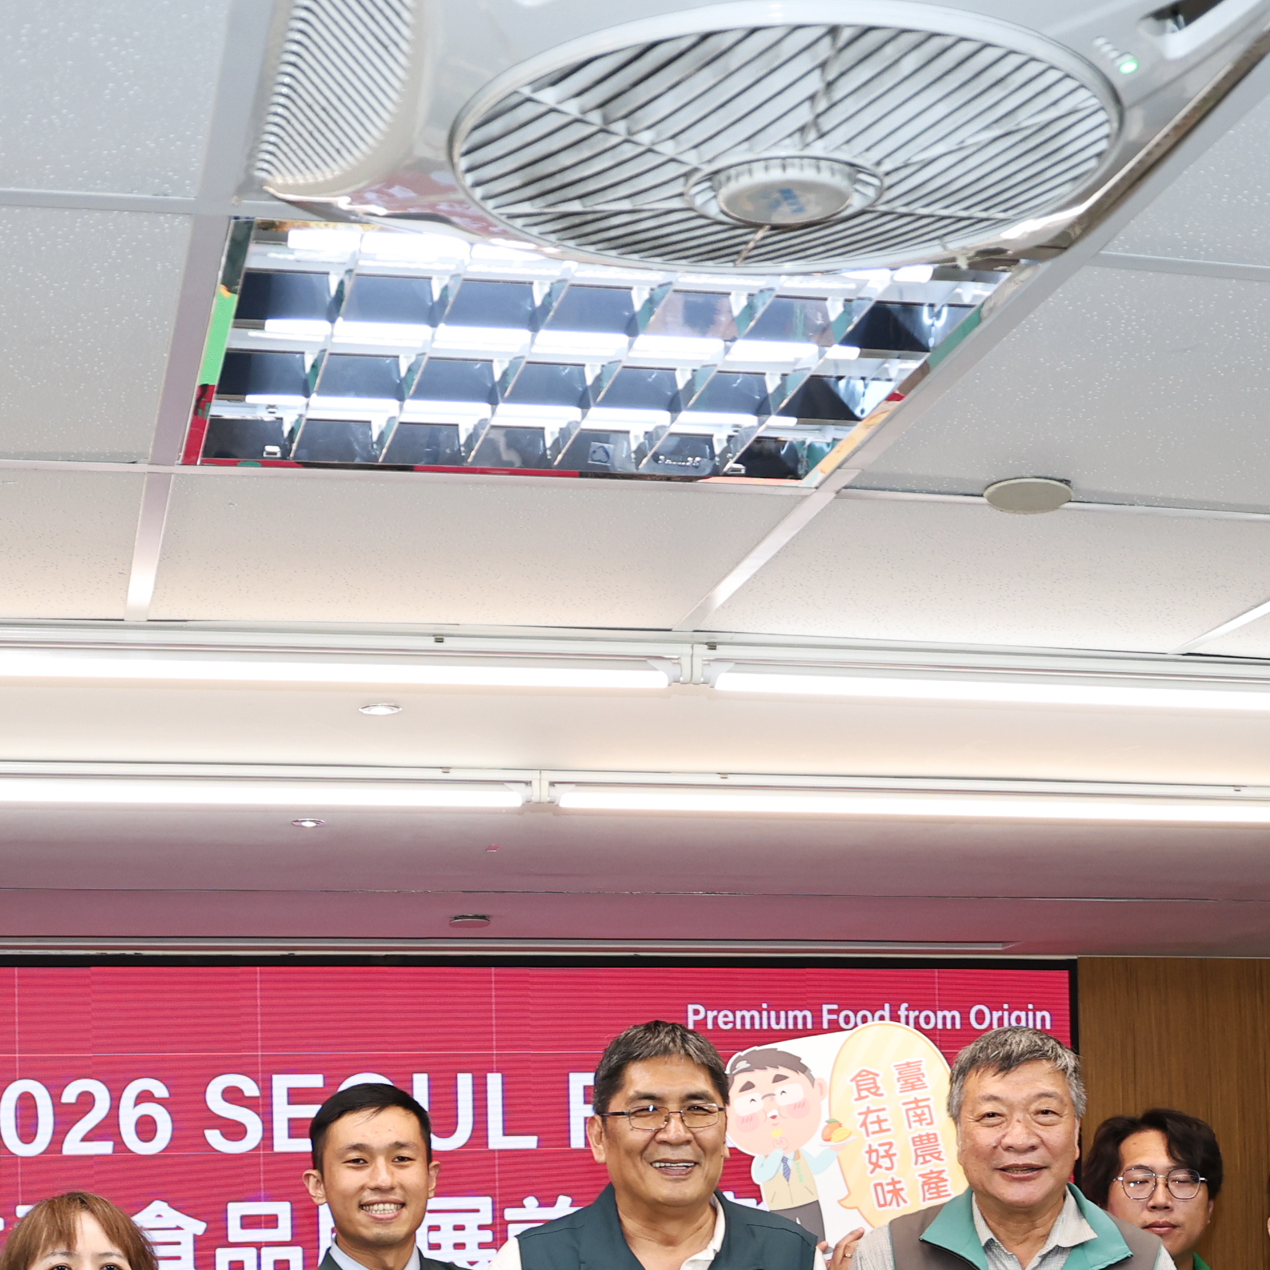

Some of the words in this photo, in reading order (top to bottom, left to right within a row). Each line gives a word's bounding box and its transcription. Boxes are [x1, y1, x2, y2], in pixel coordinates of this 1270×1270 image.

[687, 1004, 816, 1030] Premium
[822, 1004, 891, 1030] Food
[898, 1004, 962, 1030] from
[969, 1004, 1052, 1031] Origin
[204, 1072, 539, 1154] SEUL
[848, 1067, 909, 1211] 食在好味
[893, 1058, 955, 1205] 臺南農產
